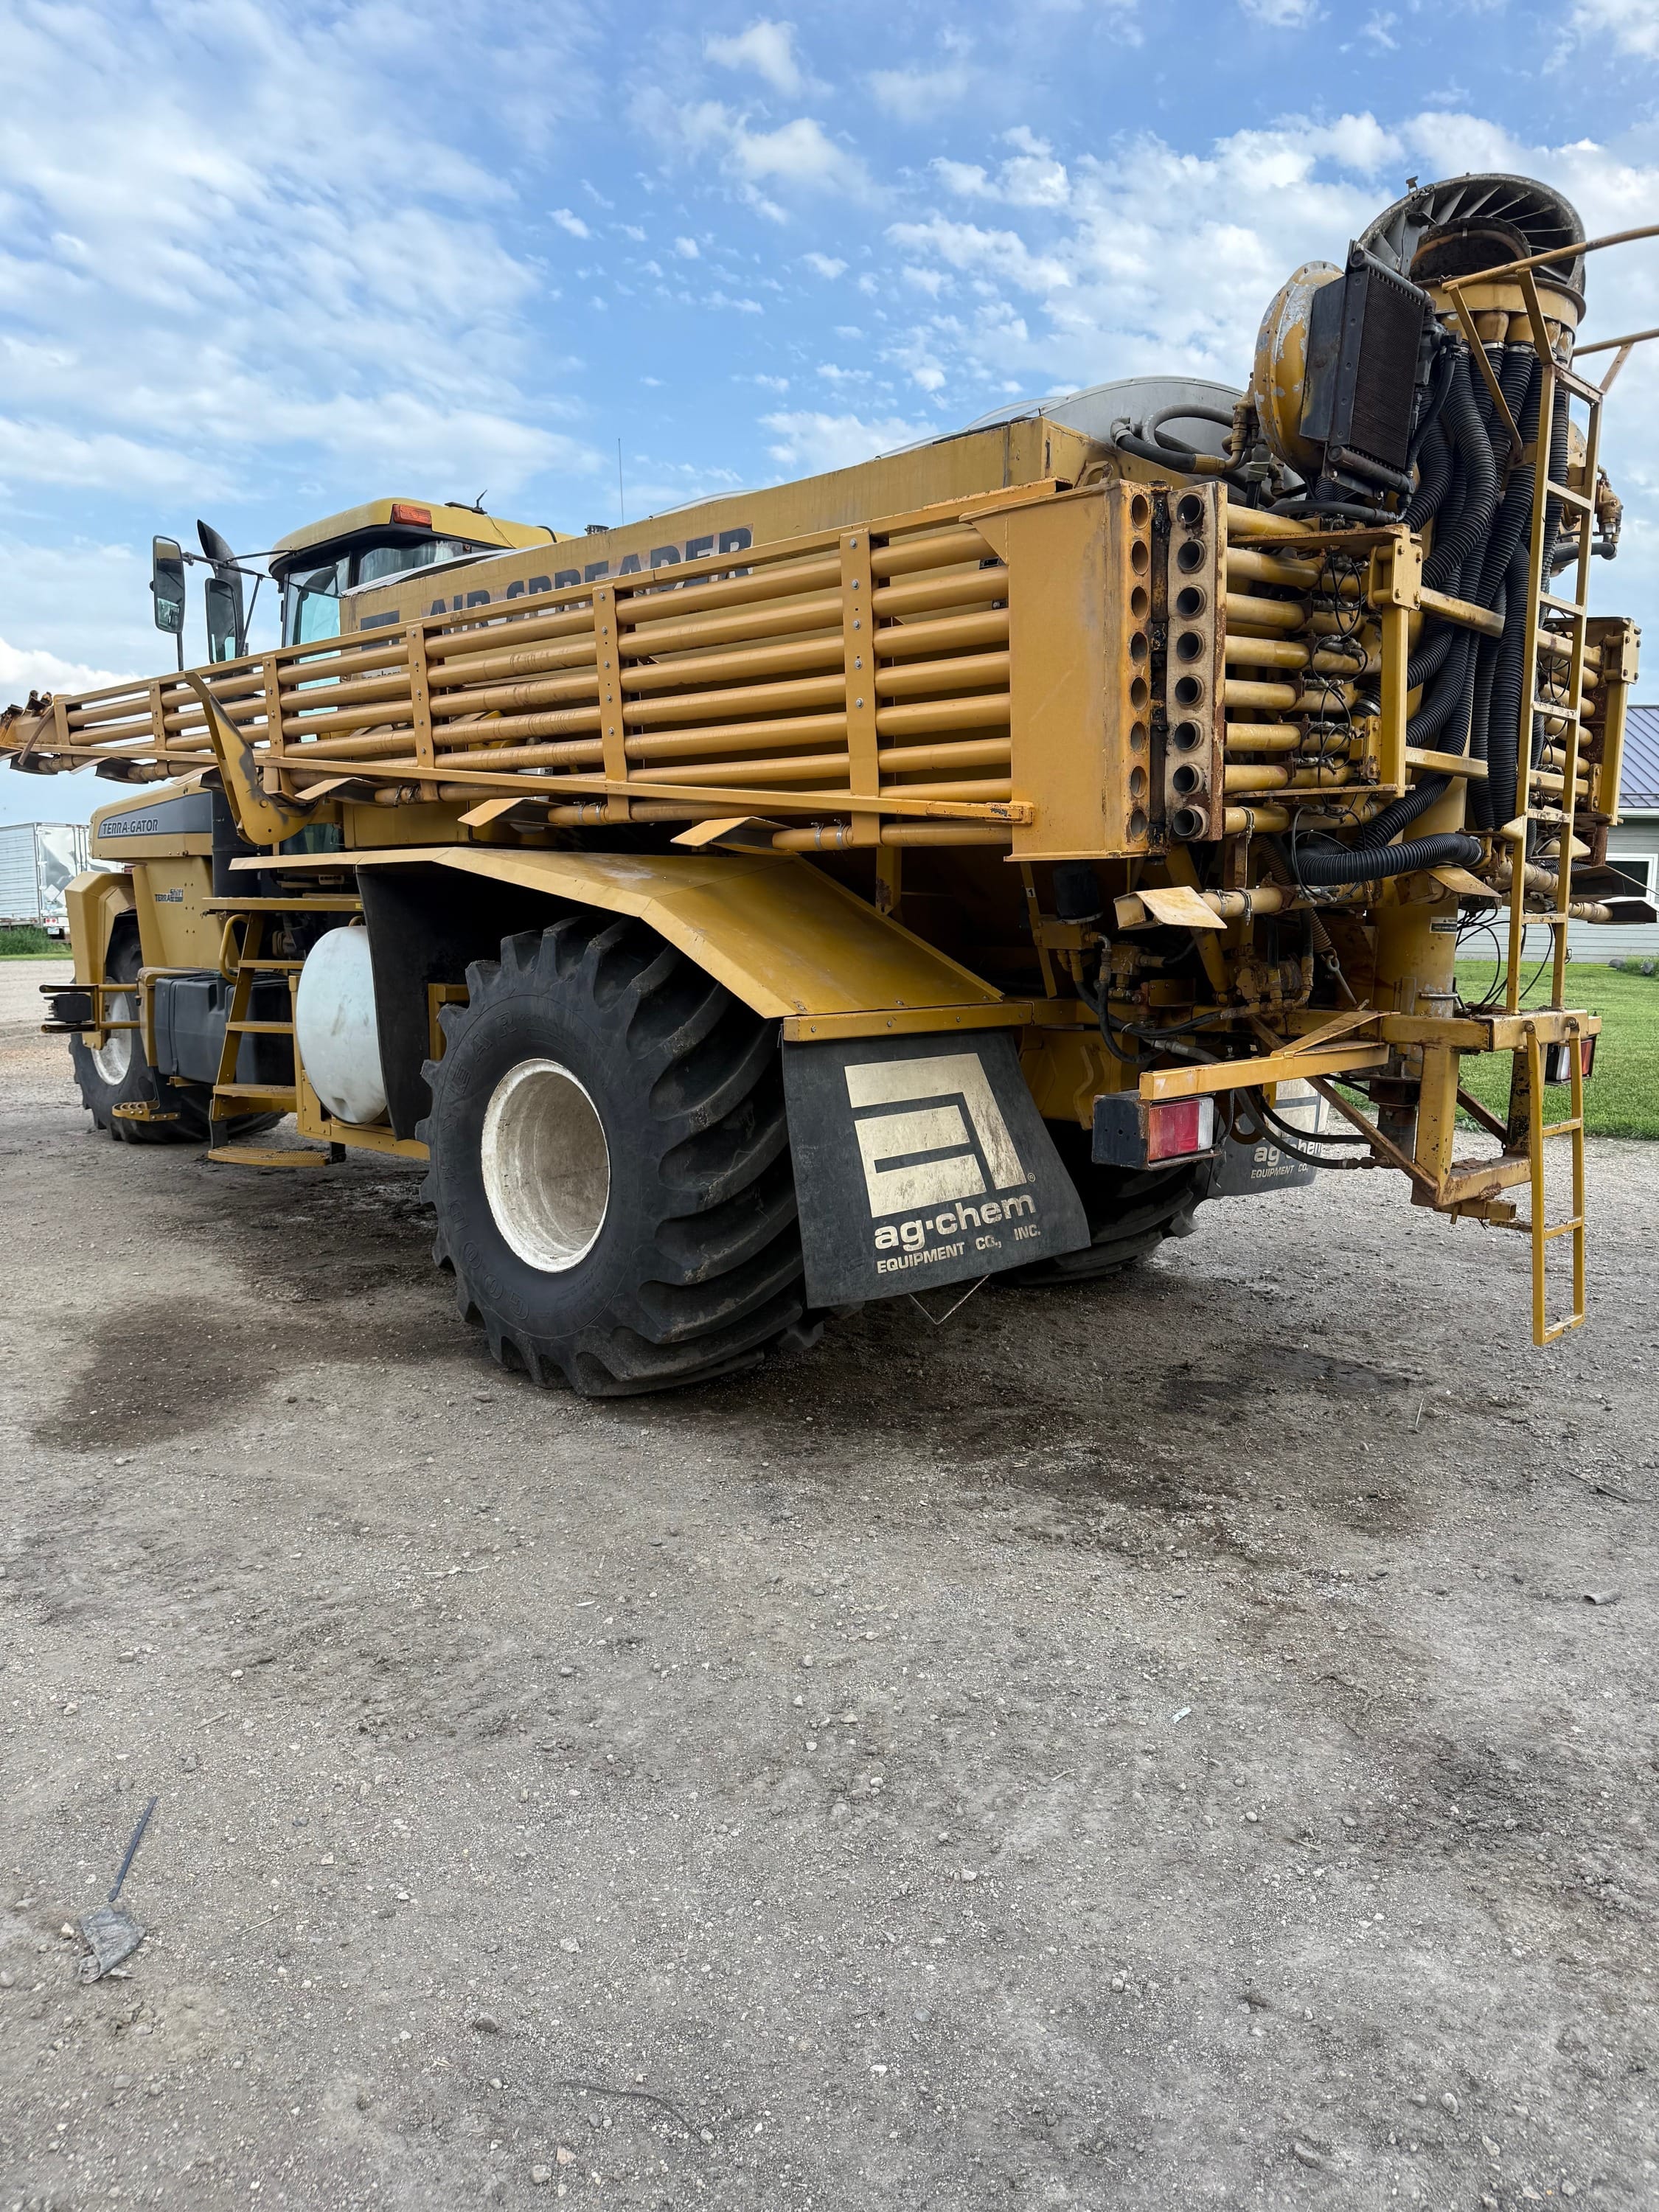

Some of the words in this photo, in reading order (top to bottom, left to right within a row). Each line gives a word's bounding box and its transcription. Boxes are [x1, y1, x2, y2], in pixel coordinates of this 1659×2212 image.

[102, 818, 159, 835] TERRA-GATOR
[1251, 1165, 1295, 1179] EQUIPMENT
[877, 1242, 965, 1273] EQUIPMENT
[1014, 1224, 1041, 1241] INC.
